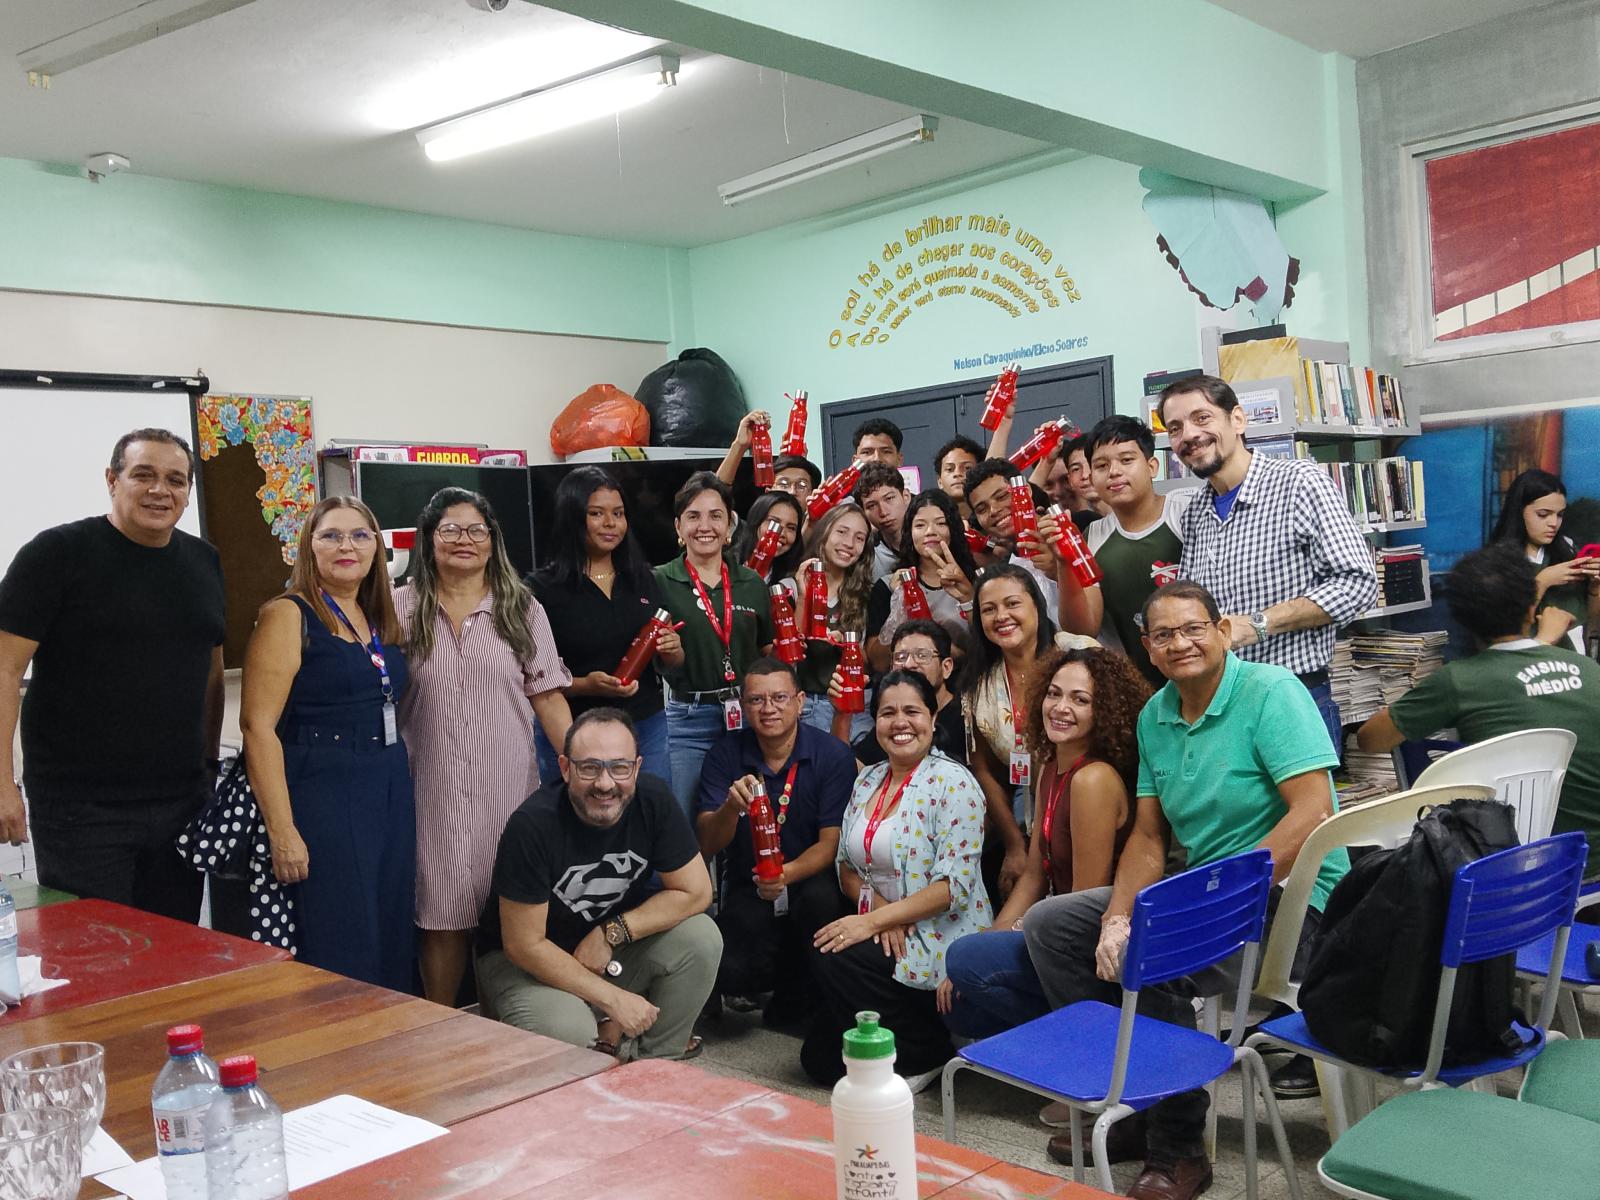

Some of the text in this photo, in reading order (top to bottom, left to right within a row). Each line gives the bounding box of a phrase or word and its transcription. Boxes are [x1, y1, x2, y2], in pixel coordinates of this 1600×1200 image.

[829, 213, 1081, 349] O sol há de brilhar mais uma vez
[847, 243, 1060, 347] A luz há de chegar aos corações
[861, 326, 880, 346] Do
[877, 298, 899, 323] mal
[898, 277, 921, 301] será
[923, 263, 978, 287] queimada
[981, 269, 989, 280] a
[878, 333, 890, 344] O
[890, 306, 911, 329] amor
[970, 285, 1021, 318] novamente
[953, 357, 982, 370] Nelson
[1055, 336, 1089, 353] Soares
[1516, 661, 1580, 684] ENSINO
[1525, 676, 1583, 697] MÉDIO
